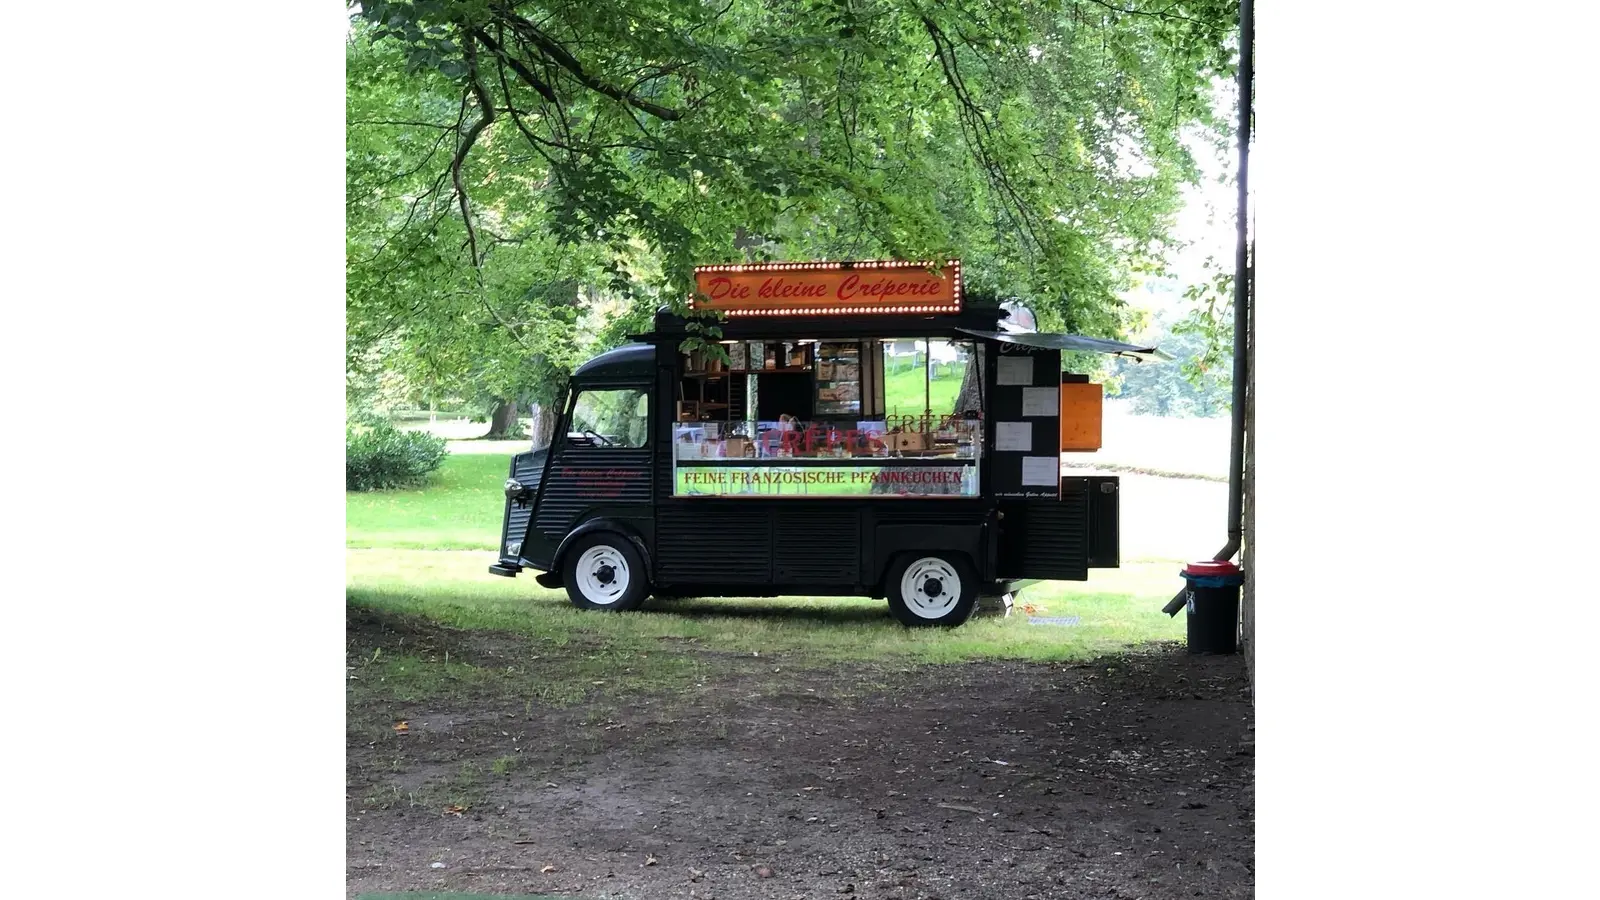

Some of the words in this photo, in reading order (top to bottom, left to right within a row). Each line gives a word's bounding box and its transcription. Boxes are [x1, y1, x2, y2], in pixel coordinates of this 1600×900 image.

[707, 276, 750, 300] Die
[758, 278, 828, 298] kleine
[684, 471, 726, 484] FEINE
[851, 471, 963, 484] PFANNKUCHEN
